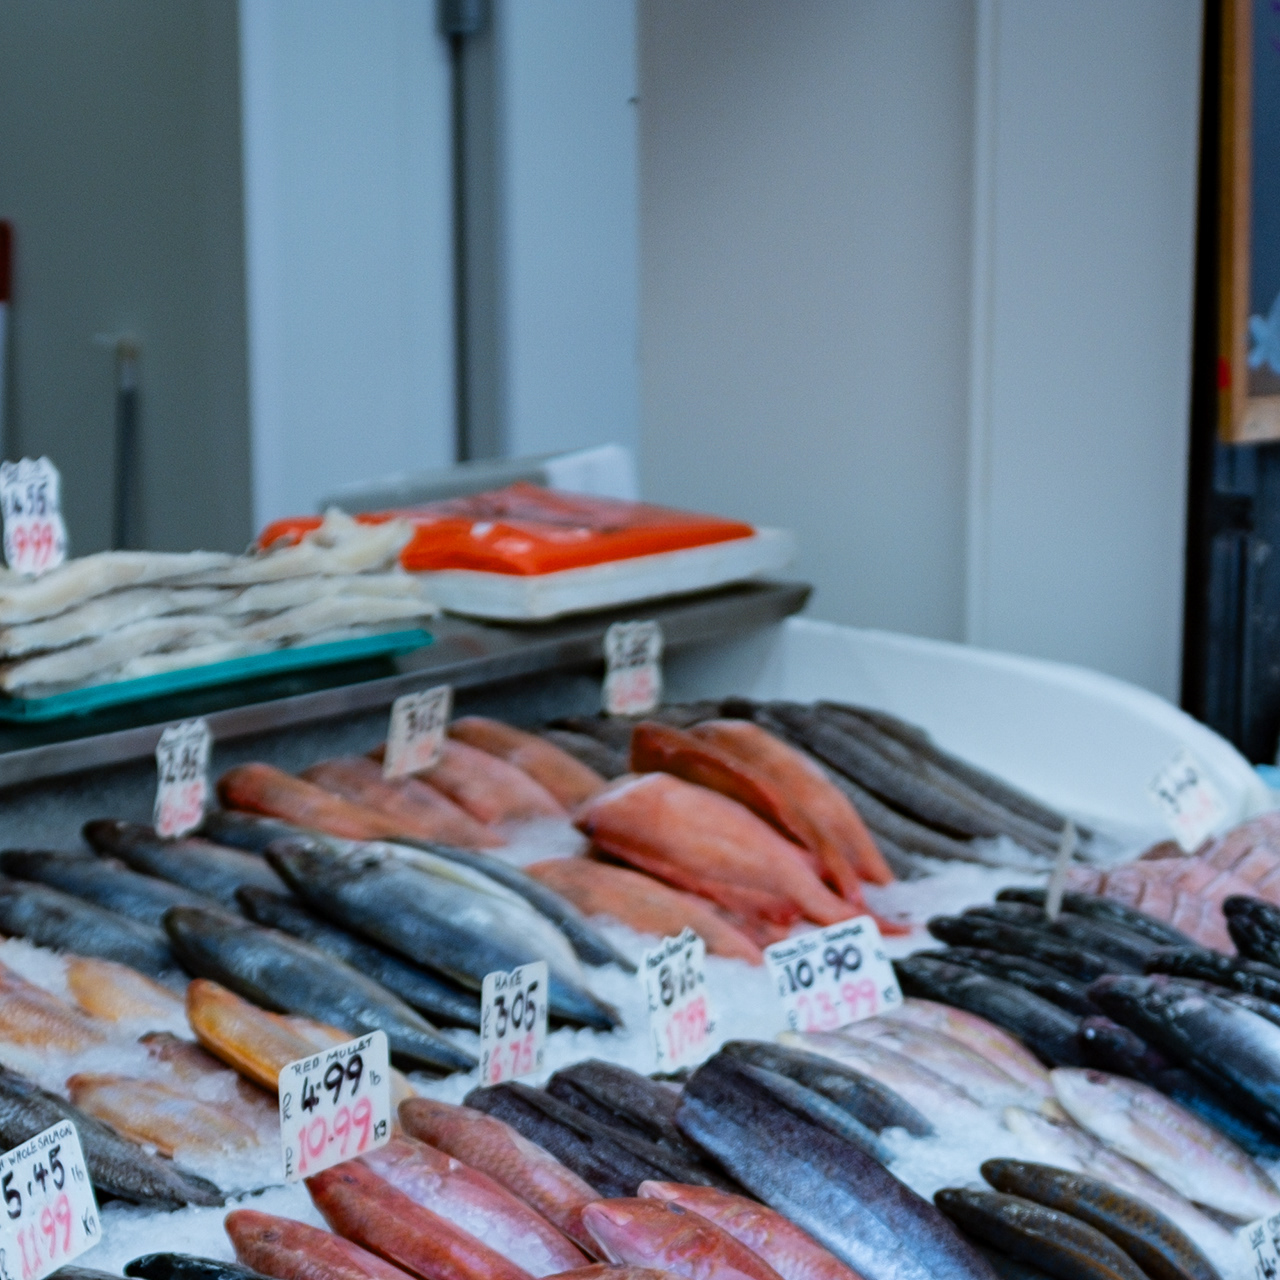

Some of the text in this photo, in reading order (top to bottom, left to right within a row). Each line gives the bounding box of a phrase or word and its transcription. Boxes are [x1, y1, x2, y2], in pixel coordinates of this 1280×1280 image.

[495, 969, 522, 991] HAKE
[291, 1036, 373, 1075] RED MULLET
[8, 1142, 37, 1166] WHOLE
[38, 1126, 72, 1148] SALMON
